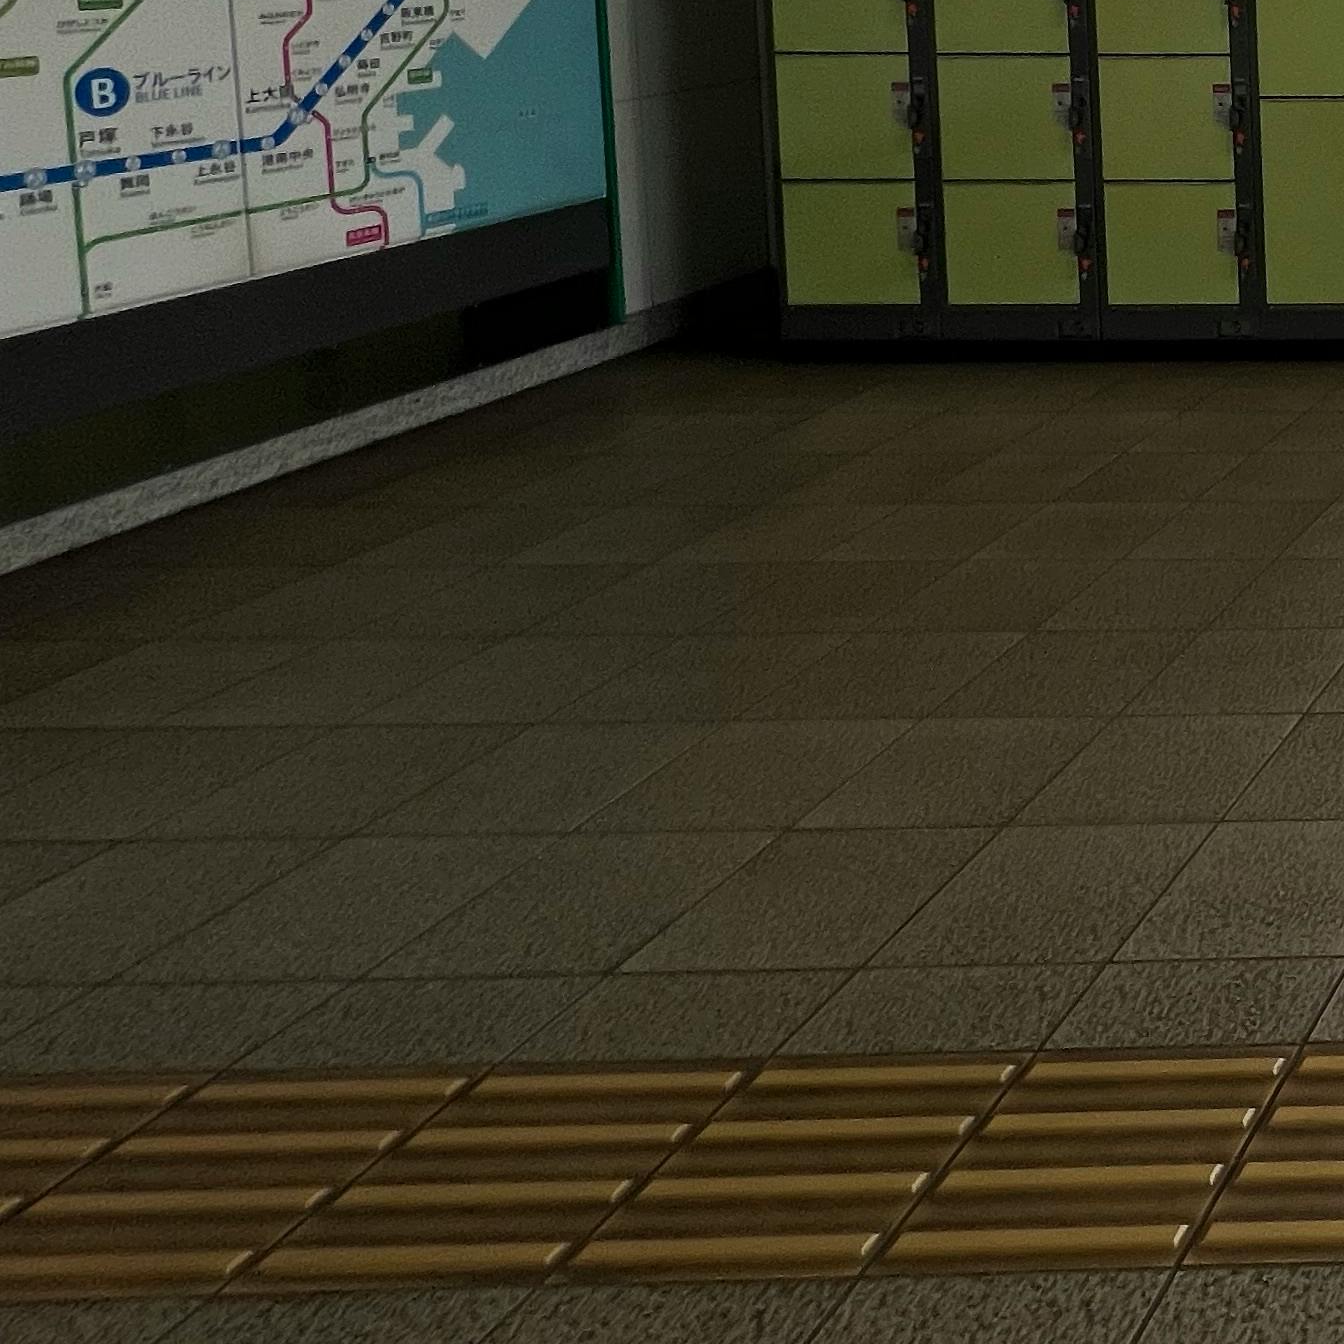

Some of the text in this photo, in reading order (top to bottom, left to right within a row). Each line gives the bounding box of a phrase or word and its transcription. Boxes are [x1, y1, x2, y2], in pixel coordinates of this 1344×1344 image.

[133, 65, 231, 90] ブルーライン
[91, 77, 115, 109] B
